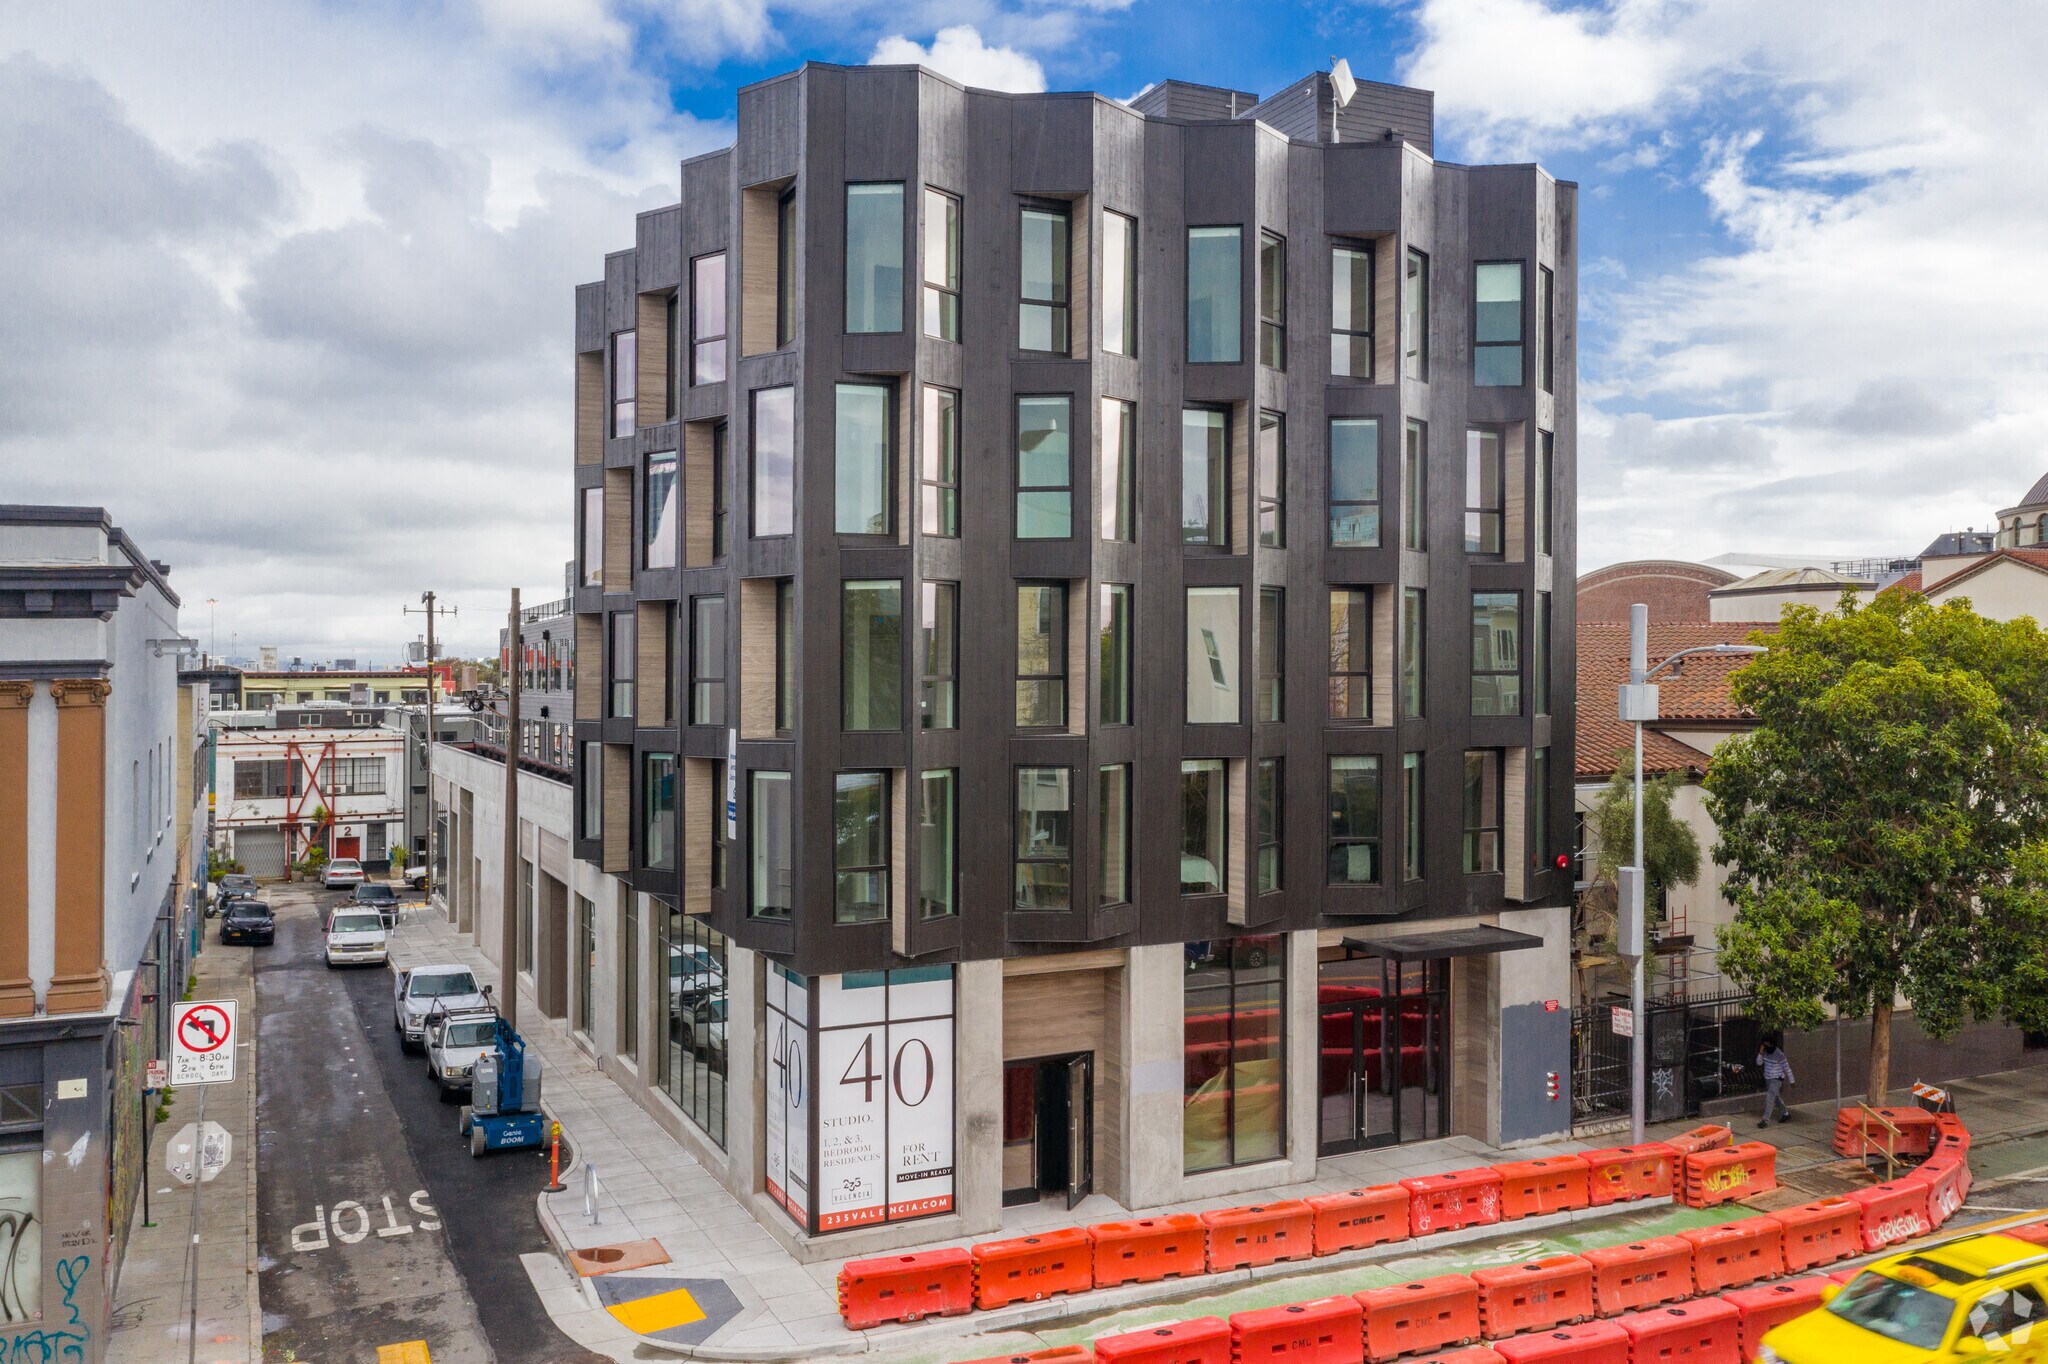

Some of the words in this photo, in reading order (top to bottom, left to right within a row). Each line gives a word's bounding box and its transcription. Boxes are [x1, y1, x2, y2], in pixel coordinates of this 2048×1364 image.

[344, 826, 351, 836] 2
[199, 1053, 230, 1062] 8:30AM
[181, 1064, 196, 1072] 2PM
[773, 1022, 802, 1108] 40
[840, 1033, 934, 1107] 40
[503, 1129, 522, 1137] Genie
[500, 1136, 524, 1145] BOOM
[844, 1135, 853, 1145] &
[823, 1144, 871, 1158] BEDROOM
[903, 1142, 926, 1154] FOR
[823, 1153, 881, 1168] RESIDENCES
[903, 1151, 941, 1167] RENT
[898, 1172, 929, 1182] MOVE-IN
[930, 1168, 952, 1177] READY
[834, 1190, 870, 1202] VALENCIA
[291, 1189, 442, 1251] STOP
[1352, 1216, 1373, 1226] CMC
[1028, 1266, 1047, 1276] CMC
[1415, 1316, 1433, 1329] CMC
[1291, 1338, 1312, 1351] CMC
